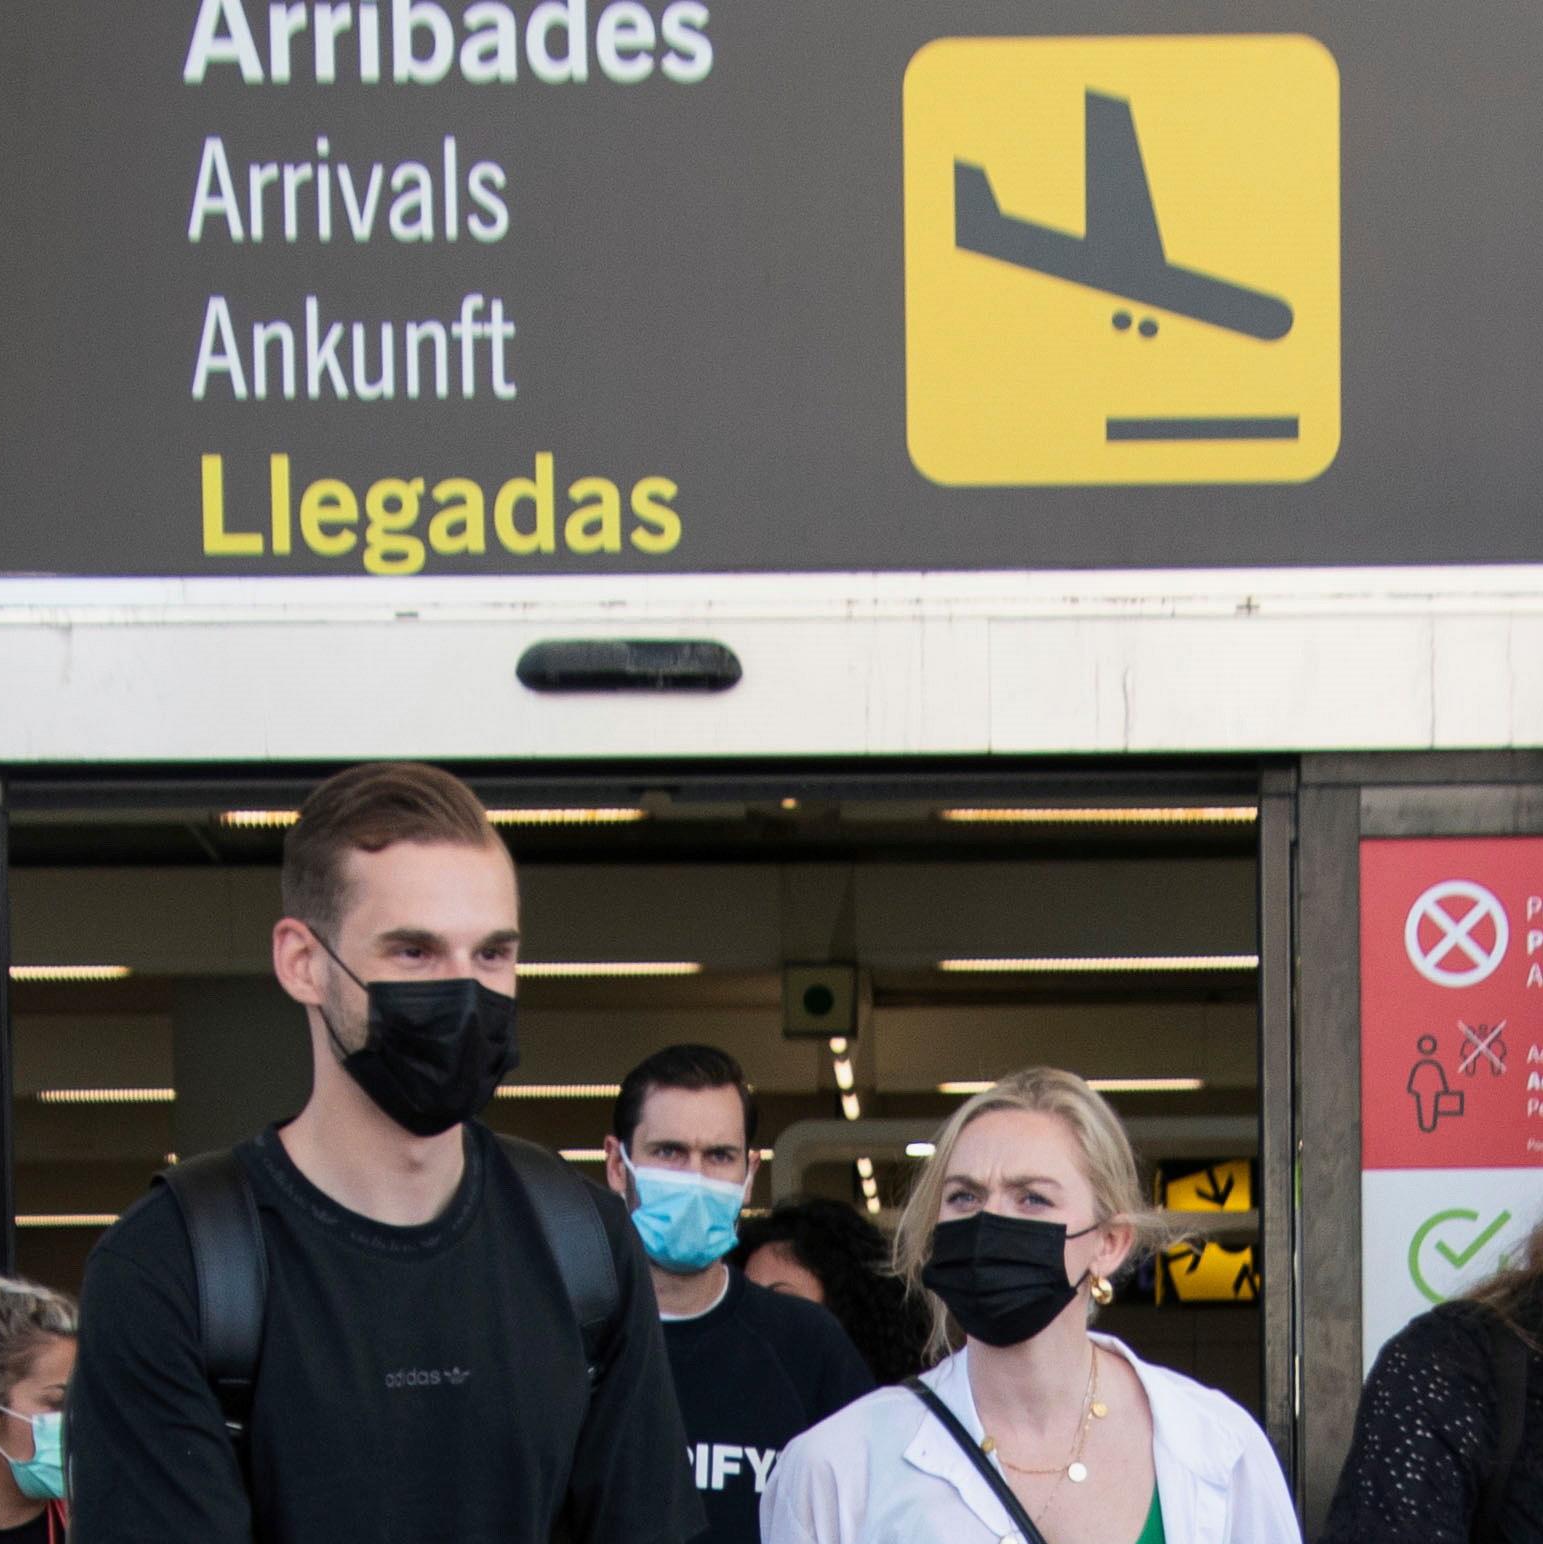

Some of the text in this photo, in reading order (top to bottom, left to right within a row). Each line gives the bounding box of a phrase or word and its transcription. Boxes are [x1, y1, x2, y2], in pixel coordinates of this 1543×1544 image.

[182, 0, 714, 83] Arribades
[188, 134, 509, 243] Arrivals
[191, 294, 517, 400] Ankunft
[201, 451, 682, 576] Llegadas
[385, 1367, 441, 1388] adidas
[687, 1443, 778, 1492] IFY
